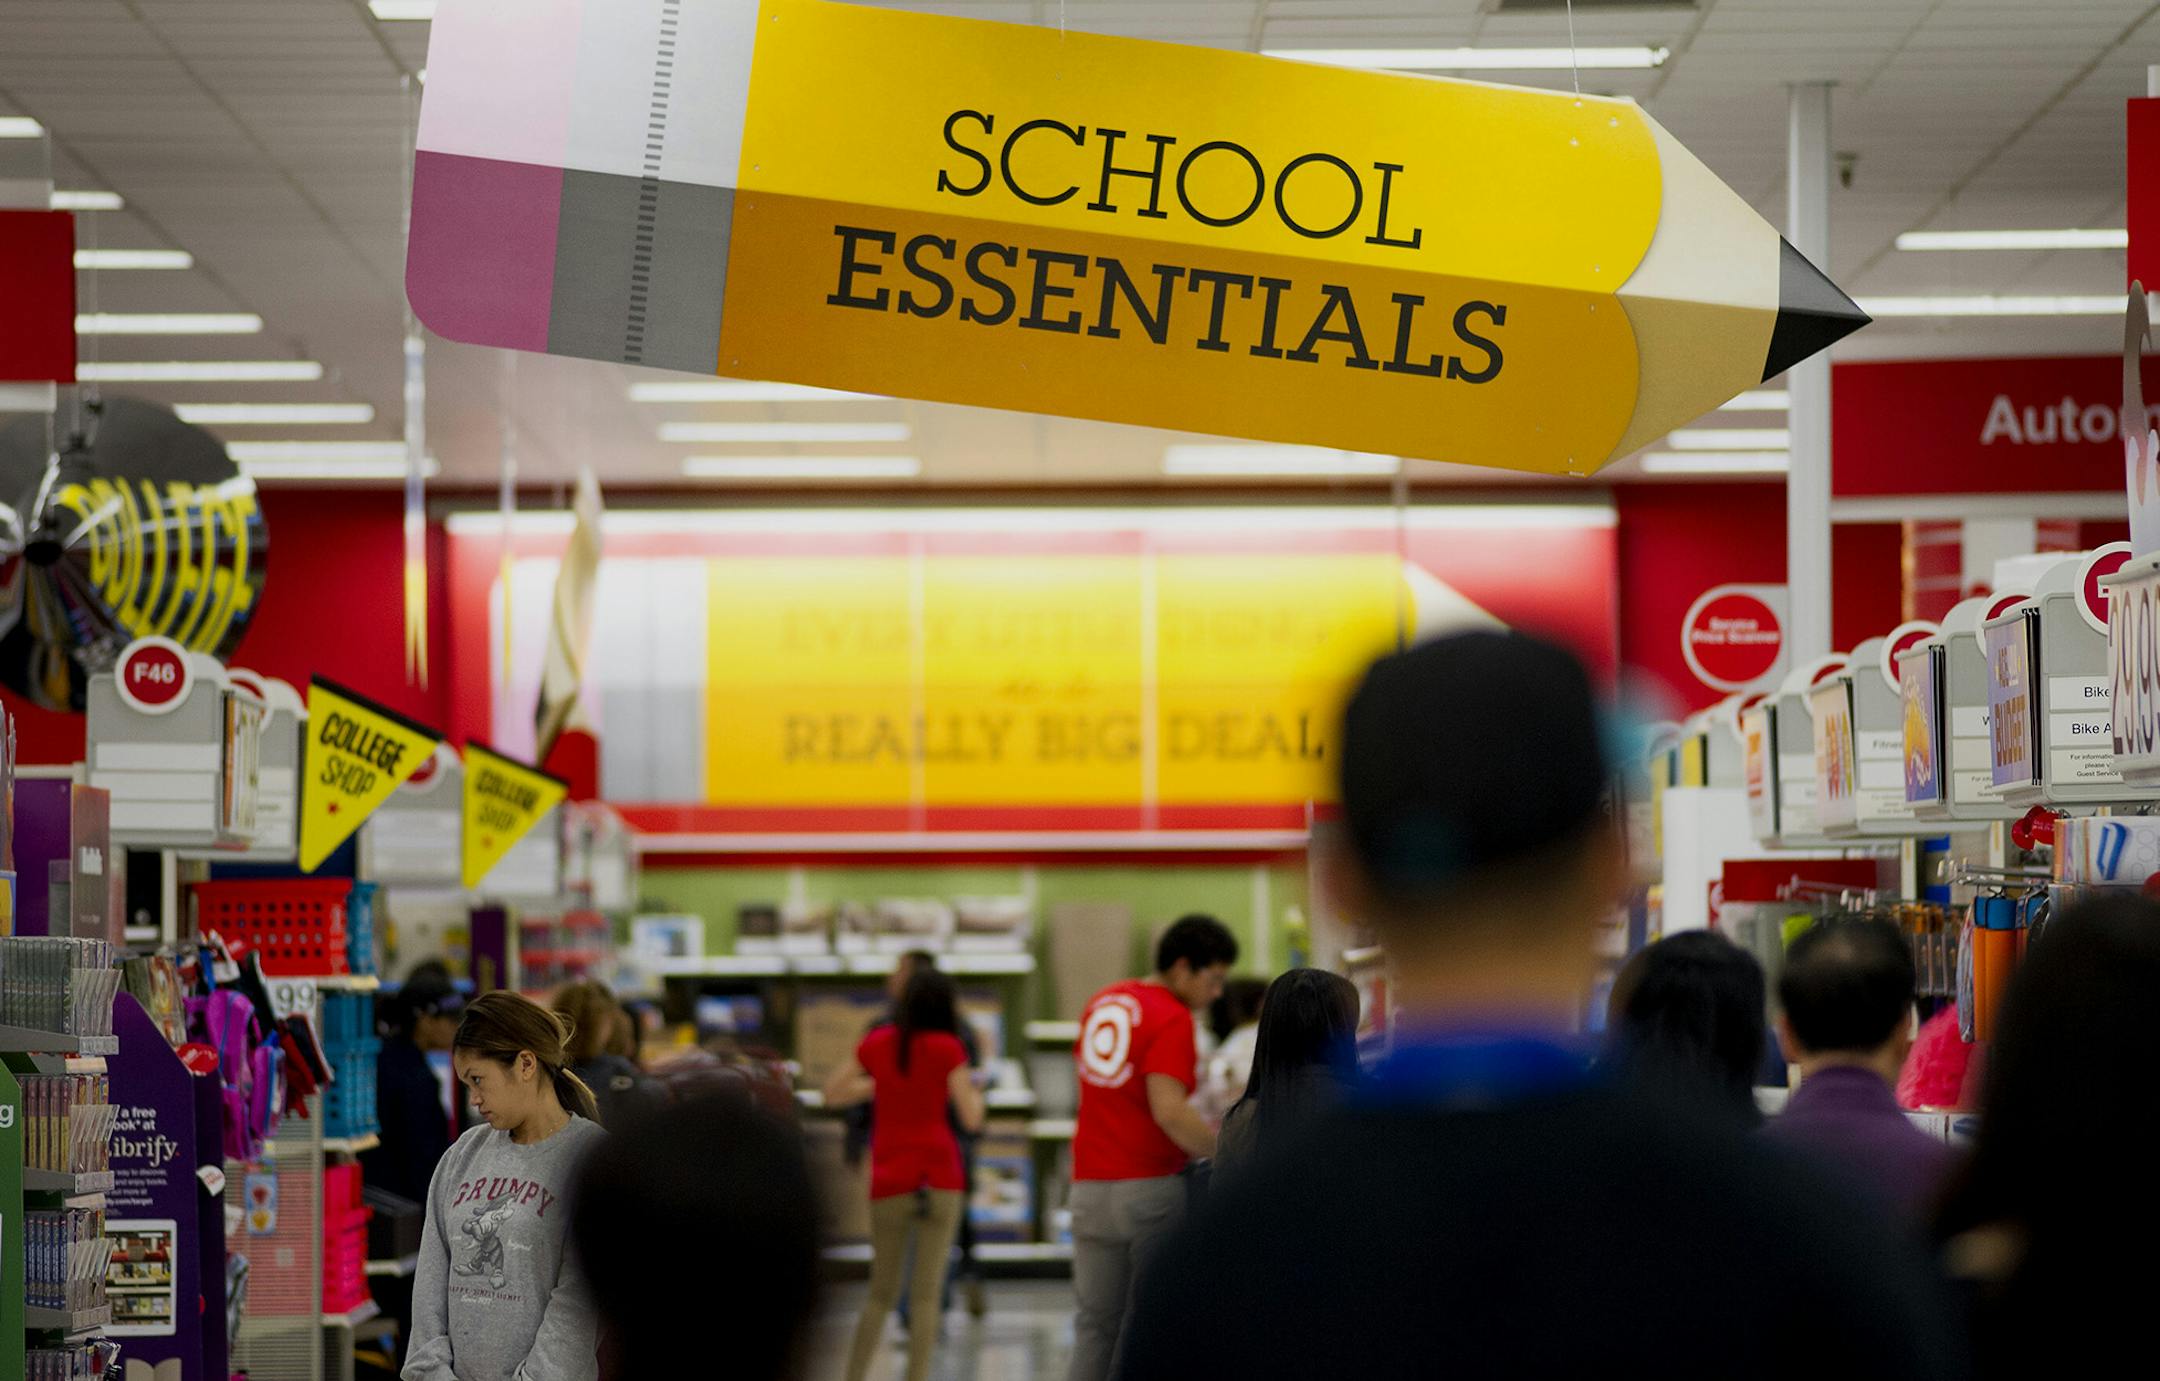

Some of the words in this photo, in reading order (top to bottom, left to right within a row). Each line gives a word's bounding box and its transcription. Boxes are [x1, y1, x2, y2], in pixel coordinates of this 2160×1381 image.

[936, 109, 1423, 250] SCHOOL
[826, 224, 1508, 385] ESSENTIALS
[133, 662, 176, 684] F46
[320, 713, 407, 777] COLLEGE
[784, 714, 1012, 764] REALLY
[1036, 714, 1141, 764] BIG
[1167, 712, 1324, 764] DEAL
[2072, 723, 2100, 735] Bike
[320, 755, 377, 800] SHOP
[2076, 770, 2096, 778] Guest
[121, 1109, 130, 1118] a
[132, 1107, 157, 1118] free
[142, 1120, 156, 1131] at
[453, 1177, 555, 1217] GRUMPY
